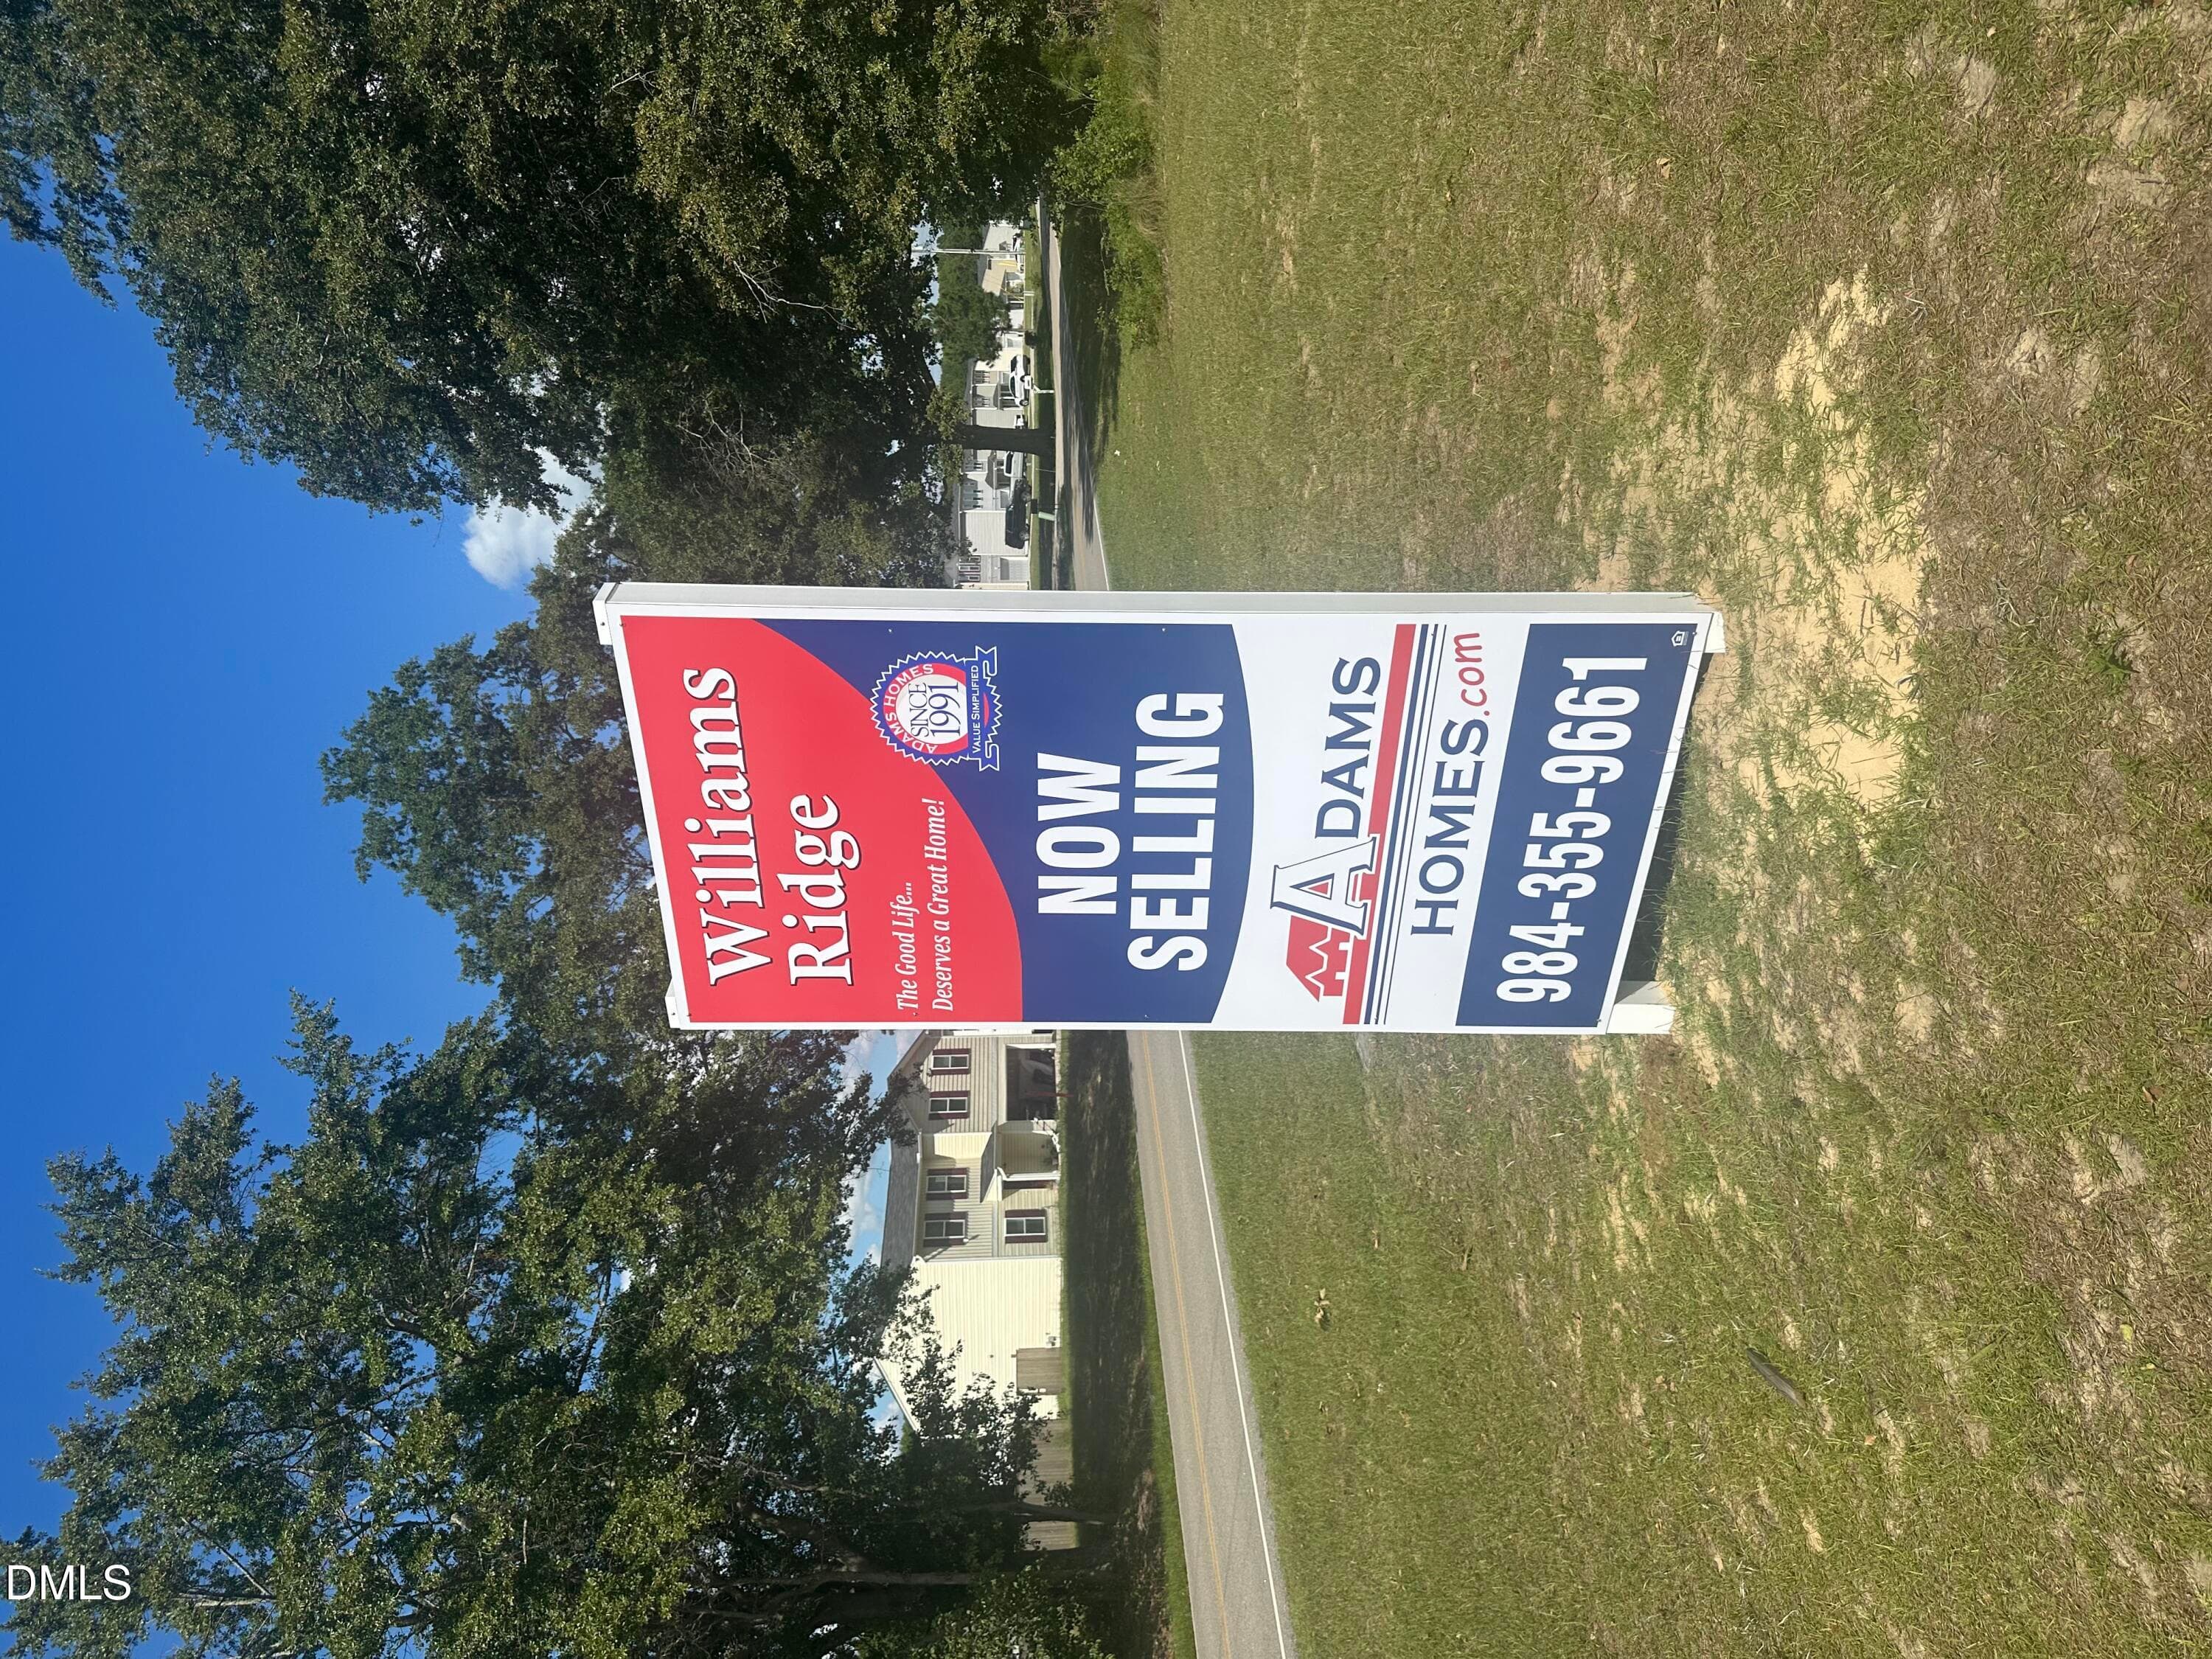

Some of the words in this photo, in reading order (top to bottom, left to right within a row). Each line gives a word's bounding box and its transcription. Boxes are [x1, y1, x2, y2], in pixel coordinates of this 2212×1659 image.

[883, 664, 933, 707] HOMES
[908, 682, 929, 737] SINCE
[928, 682, 961, 737] 1991
[971, 665, 980, 720] SIMPLIFIED
[885, 712, 938, 754] ADAMS
[972, 722, 981, 754] VALUE
[1270, 657, 1380, 936] ADAMS
[1411, 633, 1489, 936] HOMES.com
[682, 667, 772, 985] Williams
[922, 798, 947, 860] Home!
[1036, 752, 1121, 914] NOW
[1127, 693, 1223, 971] SELLING
[1496, 657, 1647, 1003] 984-355-9661
[776, 794, 860, 986] Ridge
[890, 882, 919, 928] Life...
[927, 864, 950, 914] Great
[891, 931, 917, 975] Good
[933, 920, 950, 931] a
[896, 980, 919, 1009] The
[932, 935, 953, 1011] Deserves
